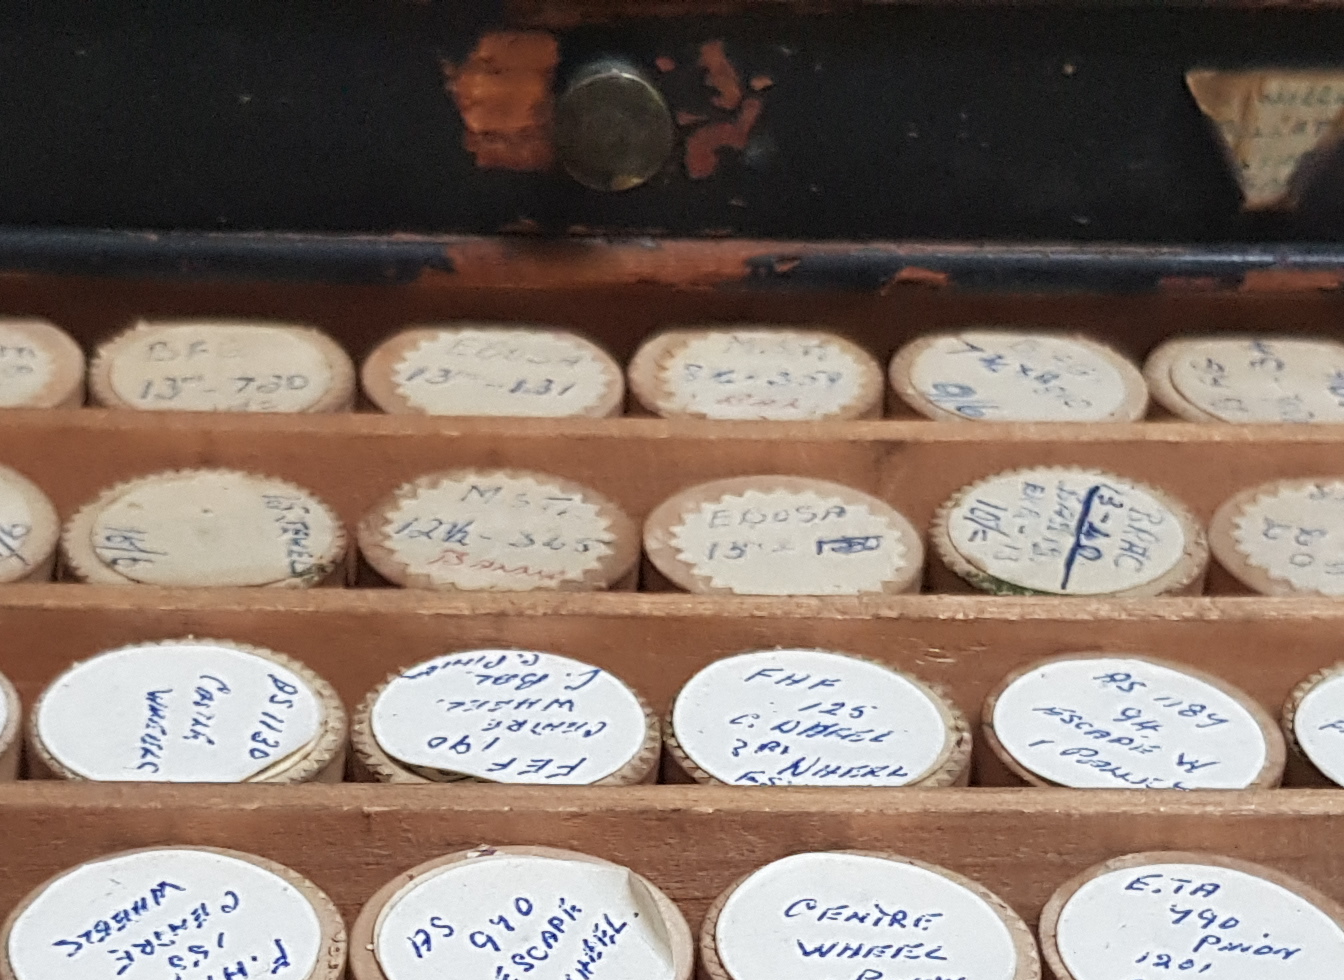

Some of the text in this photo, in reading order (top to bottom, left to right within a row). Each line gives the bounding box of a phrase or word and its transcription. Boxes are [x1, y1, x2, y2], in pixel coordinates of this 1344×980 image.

[744, 668, 842, 690] FHF
[798, 702, 878, 719] 125
[784, 898, 944, 931] CENTRE
[407, 916, 455, 959] AS
[796, 939, 947, 961] WHEEL
